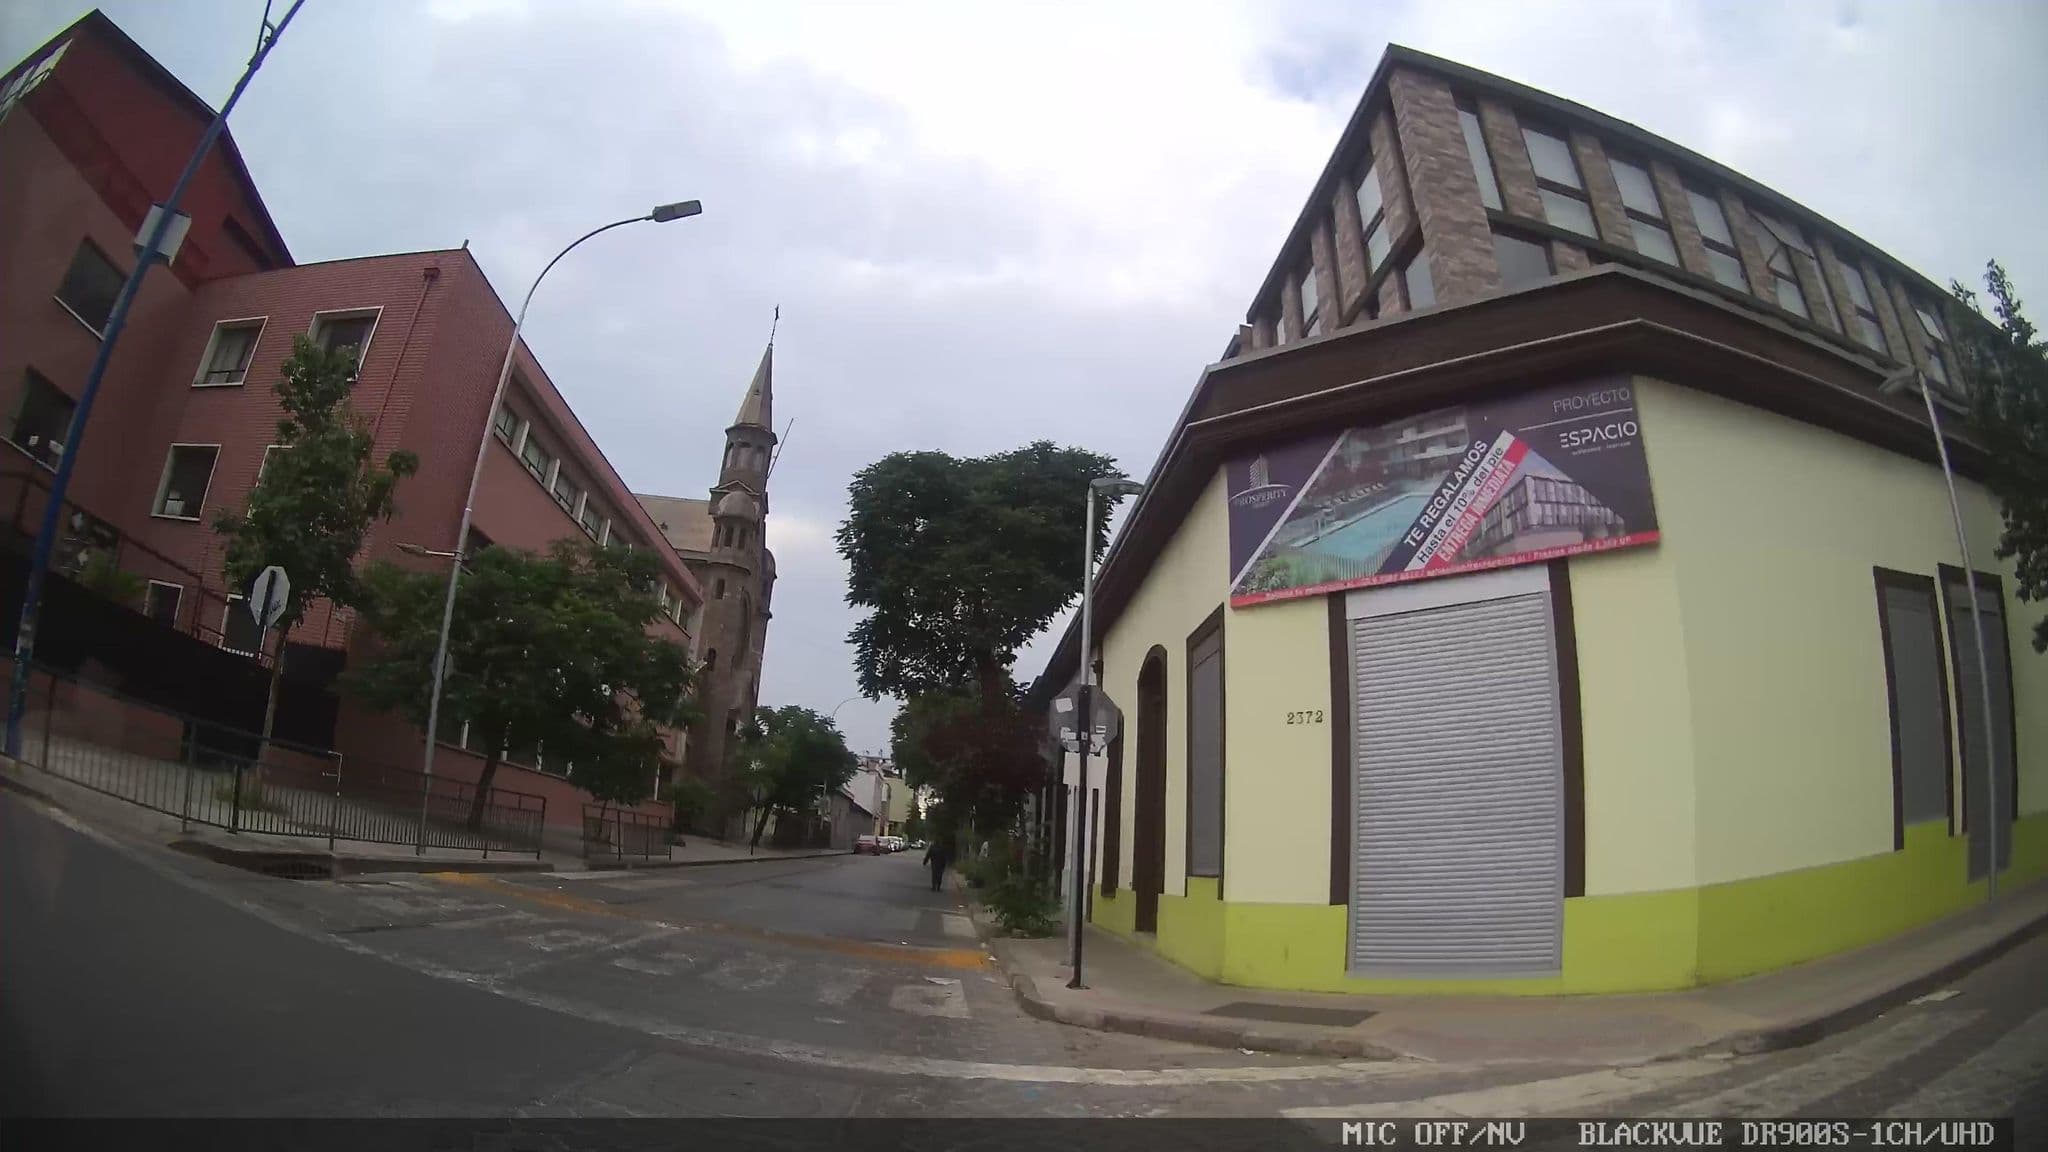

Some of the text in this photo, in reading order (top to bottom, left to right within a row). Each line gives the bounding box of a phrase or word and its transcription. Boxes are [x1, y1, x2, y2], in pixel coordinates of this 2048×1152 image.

[1553, 387, 1630, 413] PROYECTO
[1559, 421, 1637, 448] ESPACIO
[1404, 527, 1424, 547] TE
[1420, 440, 1488, 528] REGALAMOS
[1418, 447, 1504, 563] Hasta el 10% del pie
[1437, 511, 1481, 562] ENTREGA
[1287, 709, 1323, 725] 2372
